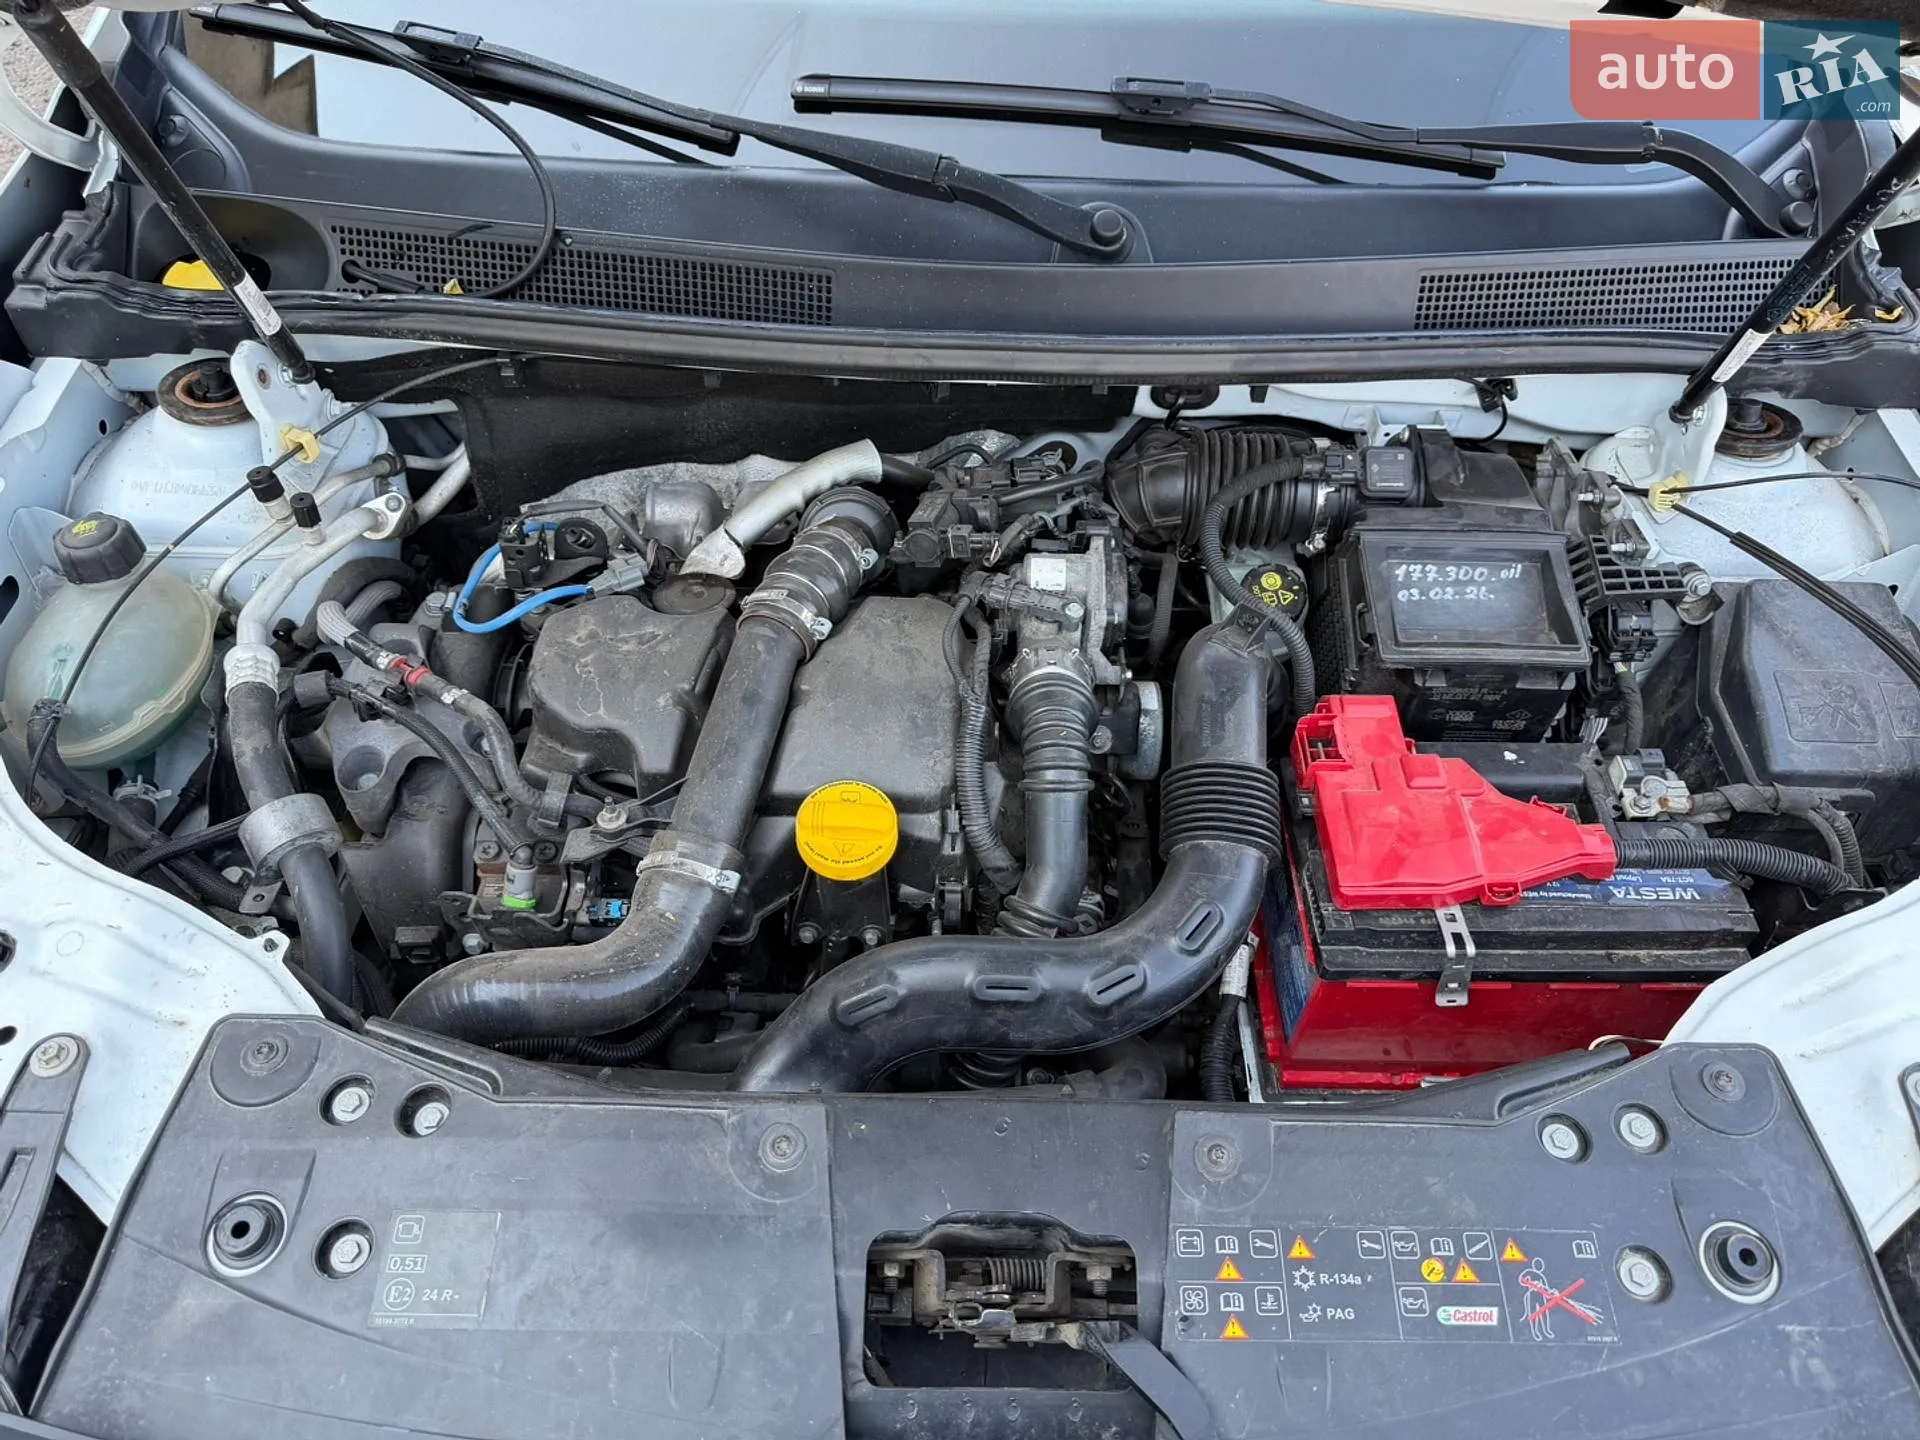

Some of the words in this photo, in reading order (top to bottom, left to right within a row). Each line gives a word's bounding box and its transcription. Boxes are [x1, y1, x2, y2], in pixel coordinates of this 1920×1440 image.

[1608, 884, 1702, 901] WESTA
[390, 1257, 423, 1271] 0,51
[1320, 1274, 1362, 1286] R-134a
[422, 1288, 438, 1301] 24
[1326, 1308, 1355, 1320] PAG
[1453, 1309, 1494, 1323] Castrol
